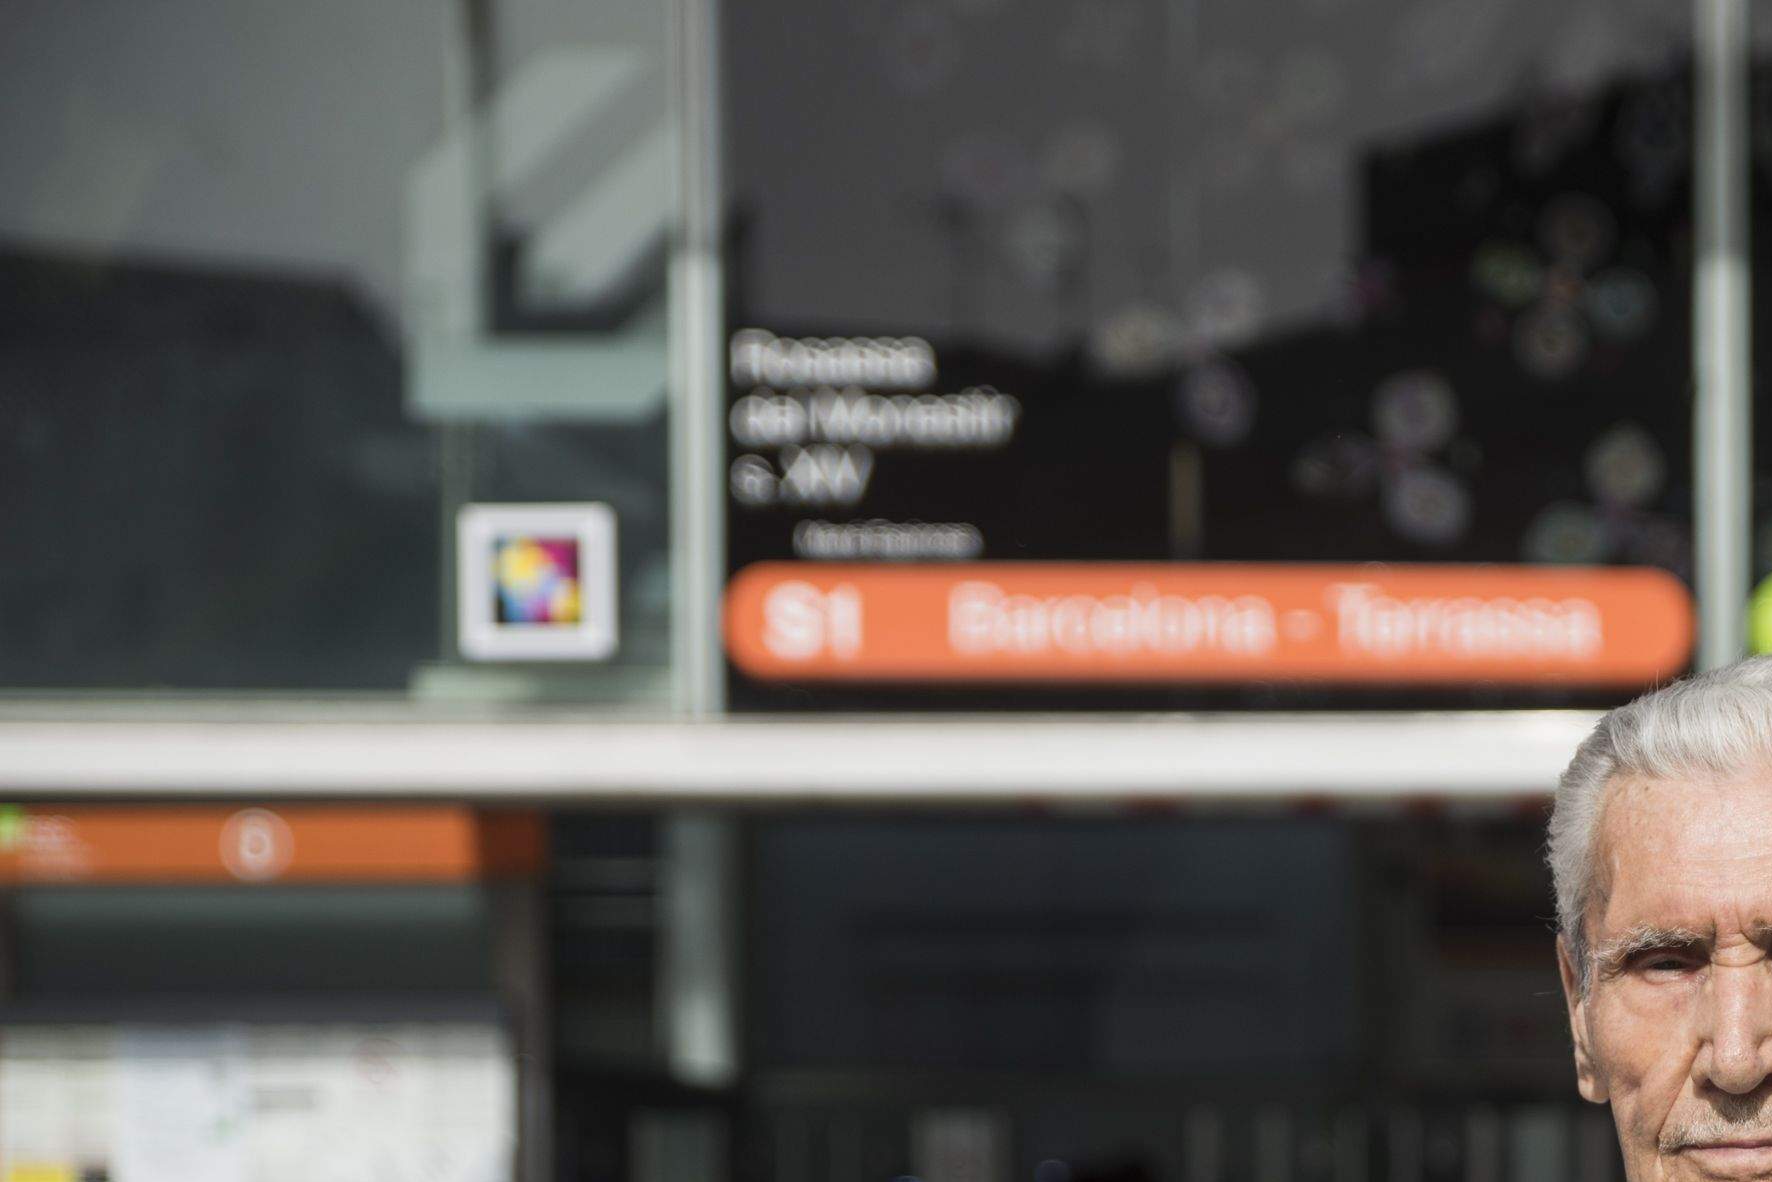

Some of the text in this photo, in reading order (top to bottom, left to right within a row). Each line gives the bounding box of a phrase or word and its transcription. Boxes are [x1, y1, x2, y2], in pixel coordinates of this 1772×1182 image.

[762, 579, 863, 663] S1
[947, 581, 1276, 656] Barcelona
[1325, 581, 1605, 658] Terrassa
